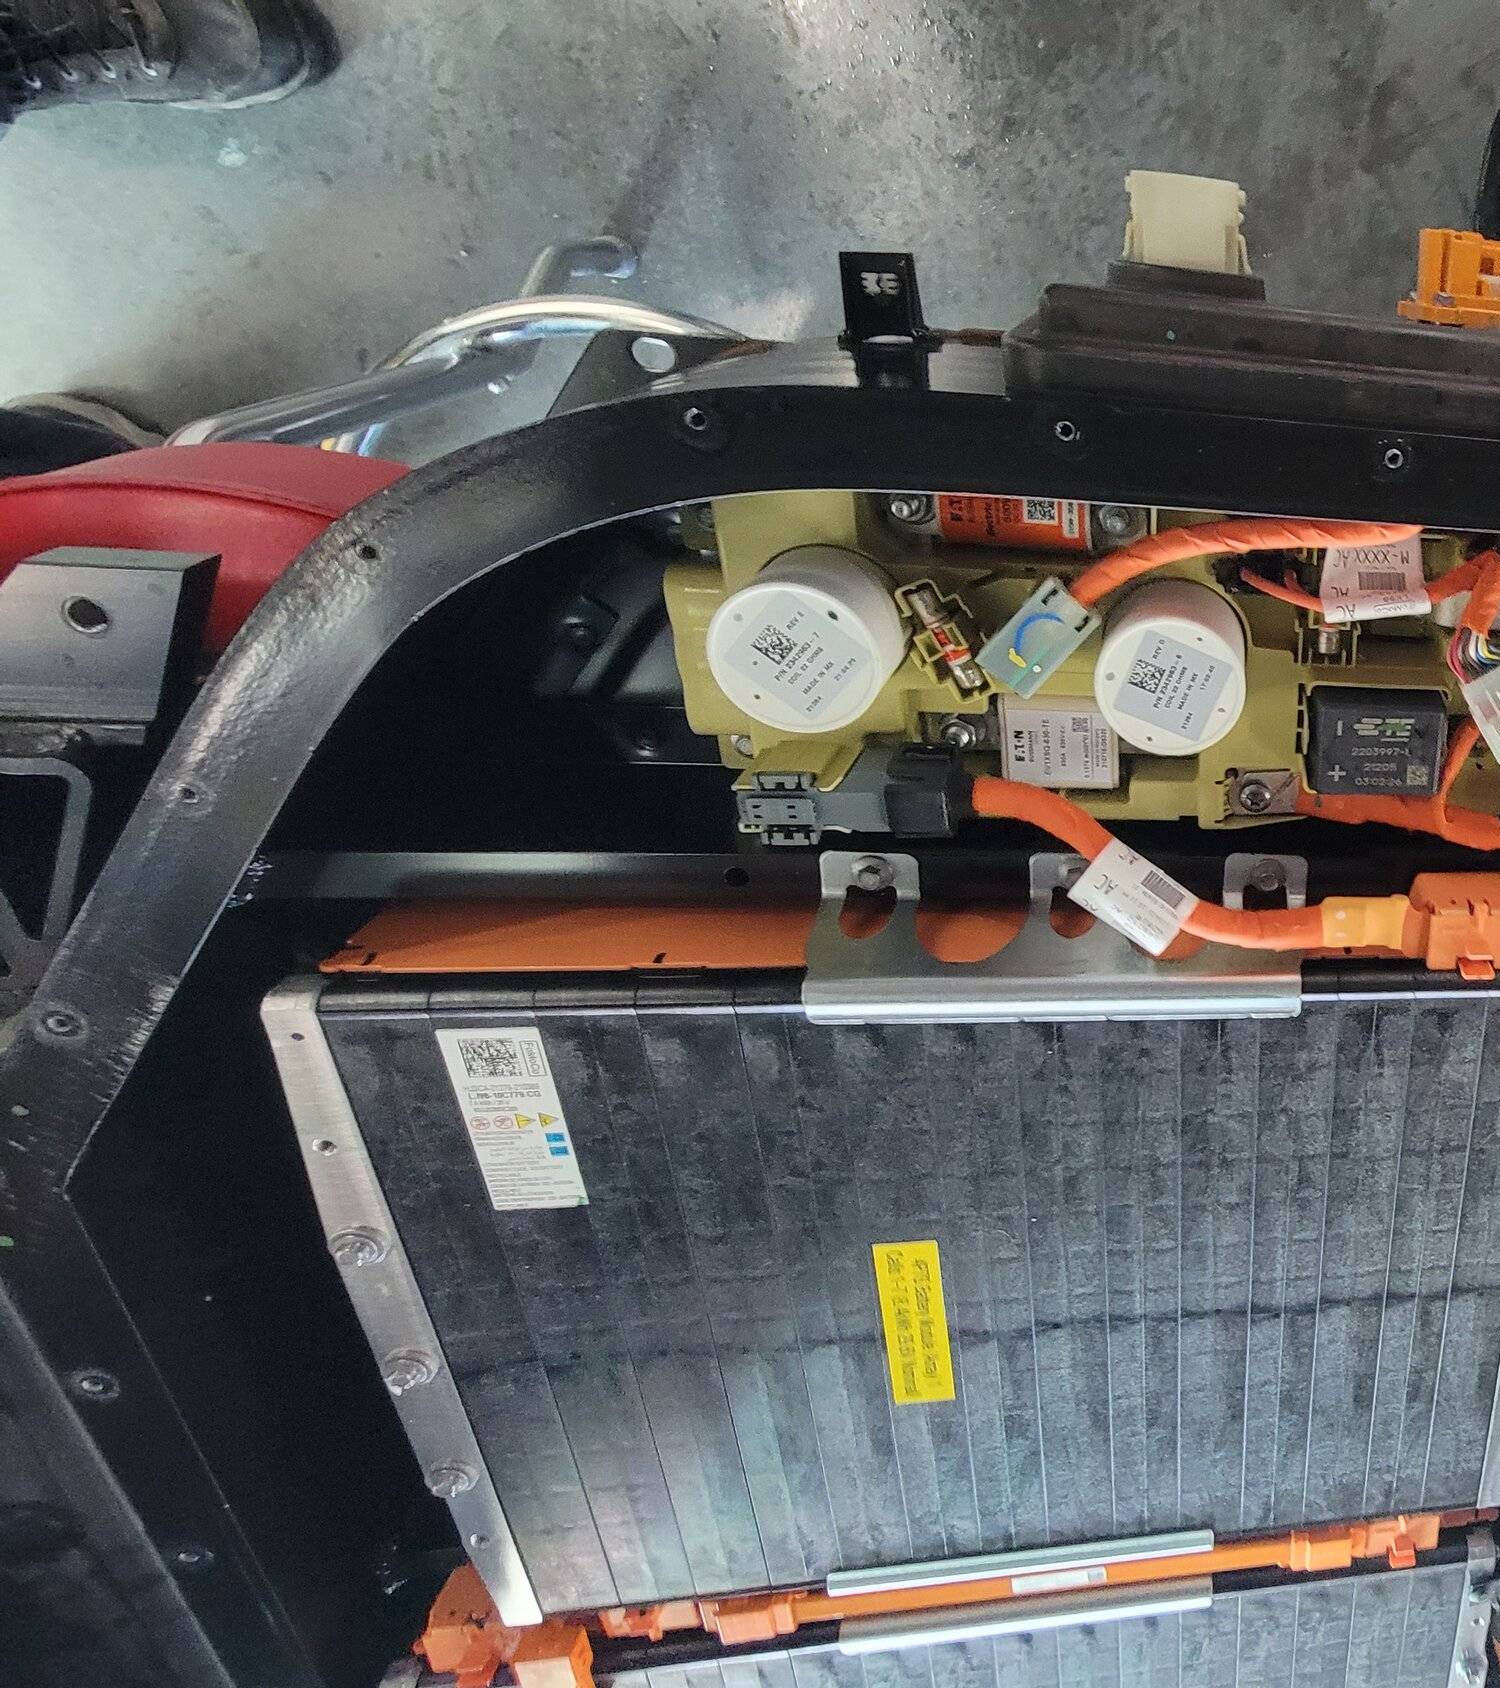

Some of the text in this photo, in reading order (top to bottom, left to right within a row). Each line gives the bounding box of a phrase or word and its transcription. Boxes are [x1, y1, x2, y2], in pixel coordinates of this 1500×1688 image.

[801, 676, 820, 695] MADE
[1176, 691, 1190, 710] MADE
[1189, 671, 1199, 683] MX
[1092, 872, 1119, 897] AC
